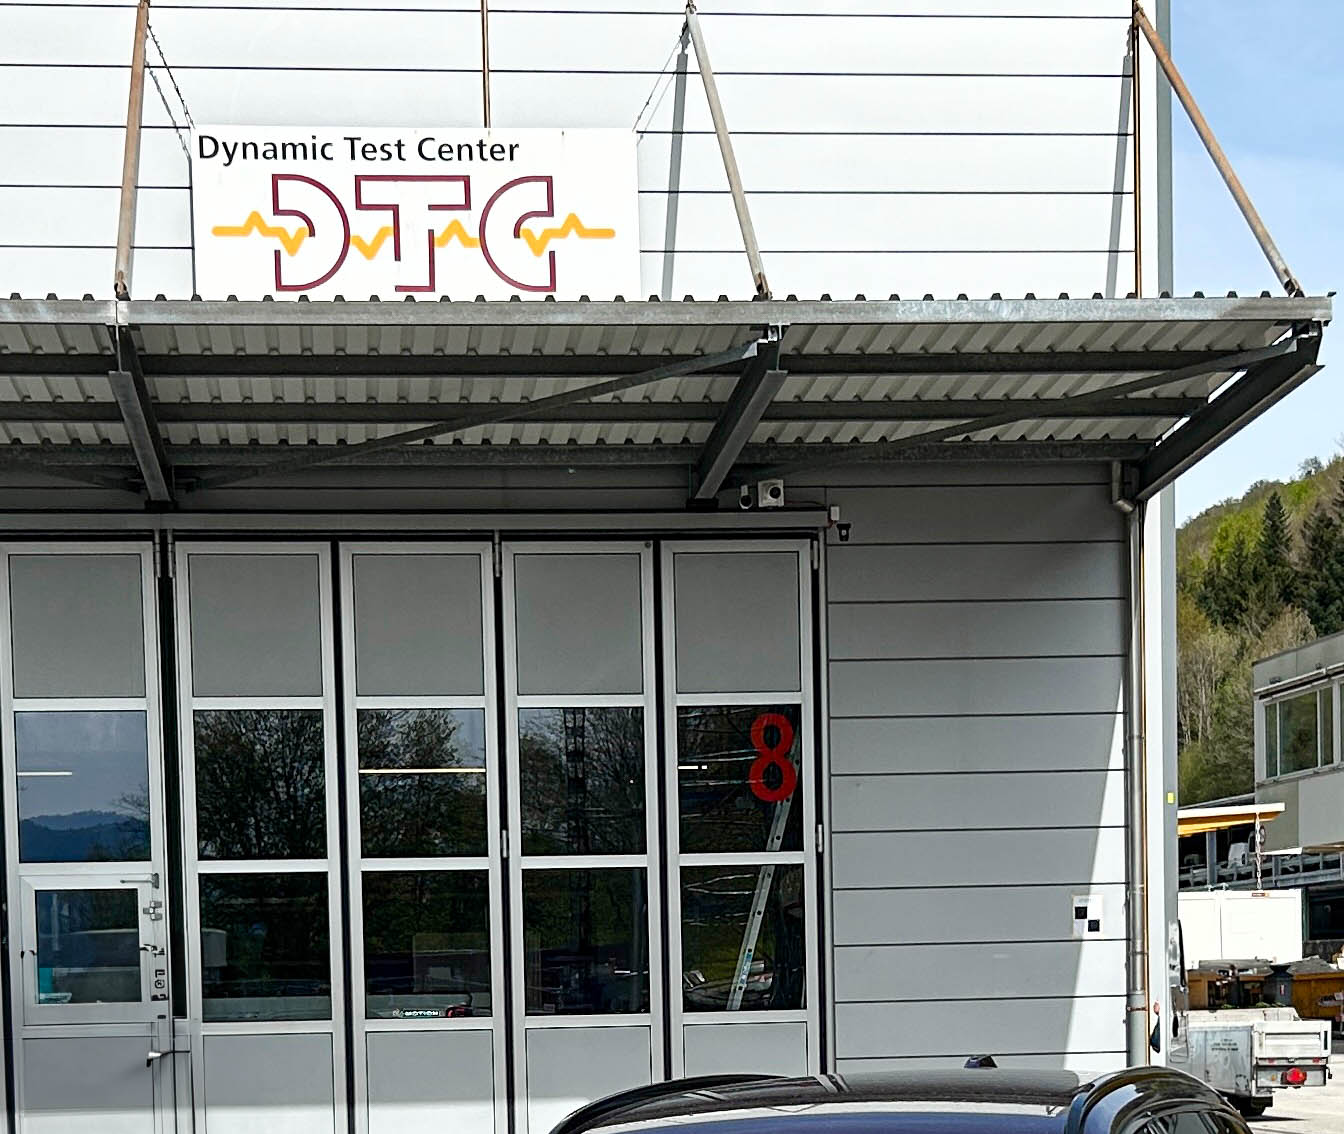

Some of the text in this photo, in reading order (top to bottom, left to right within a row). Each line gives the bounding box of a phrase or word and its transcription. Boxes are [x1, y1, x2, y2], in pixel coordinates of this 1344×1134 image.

[198, 134, 520, 166] Dynamic Test Center
[272, 174, 556, 293] DTC
[749, 713, 797, 803] 8
